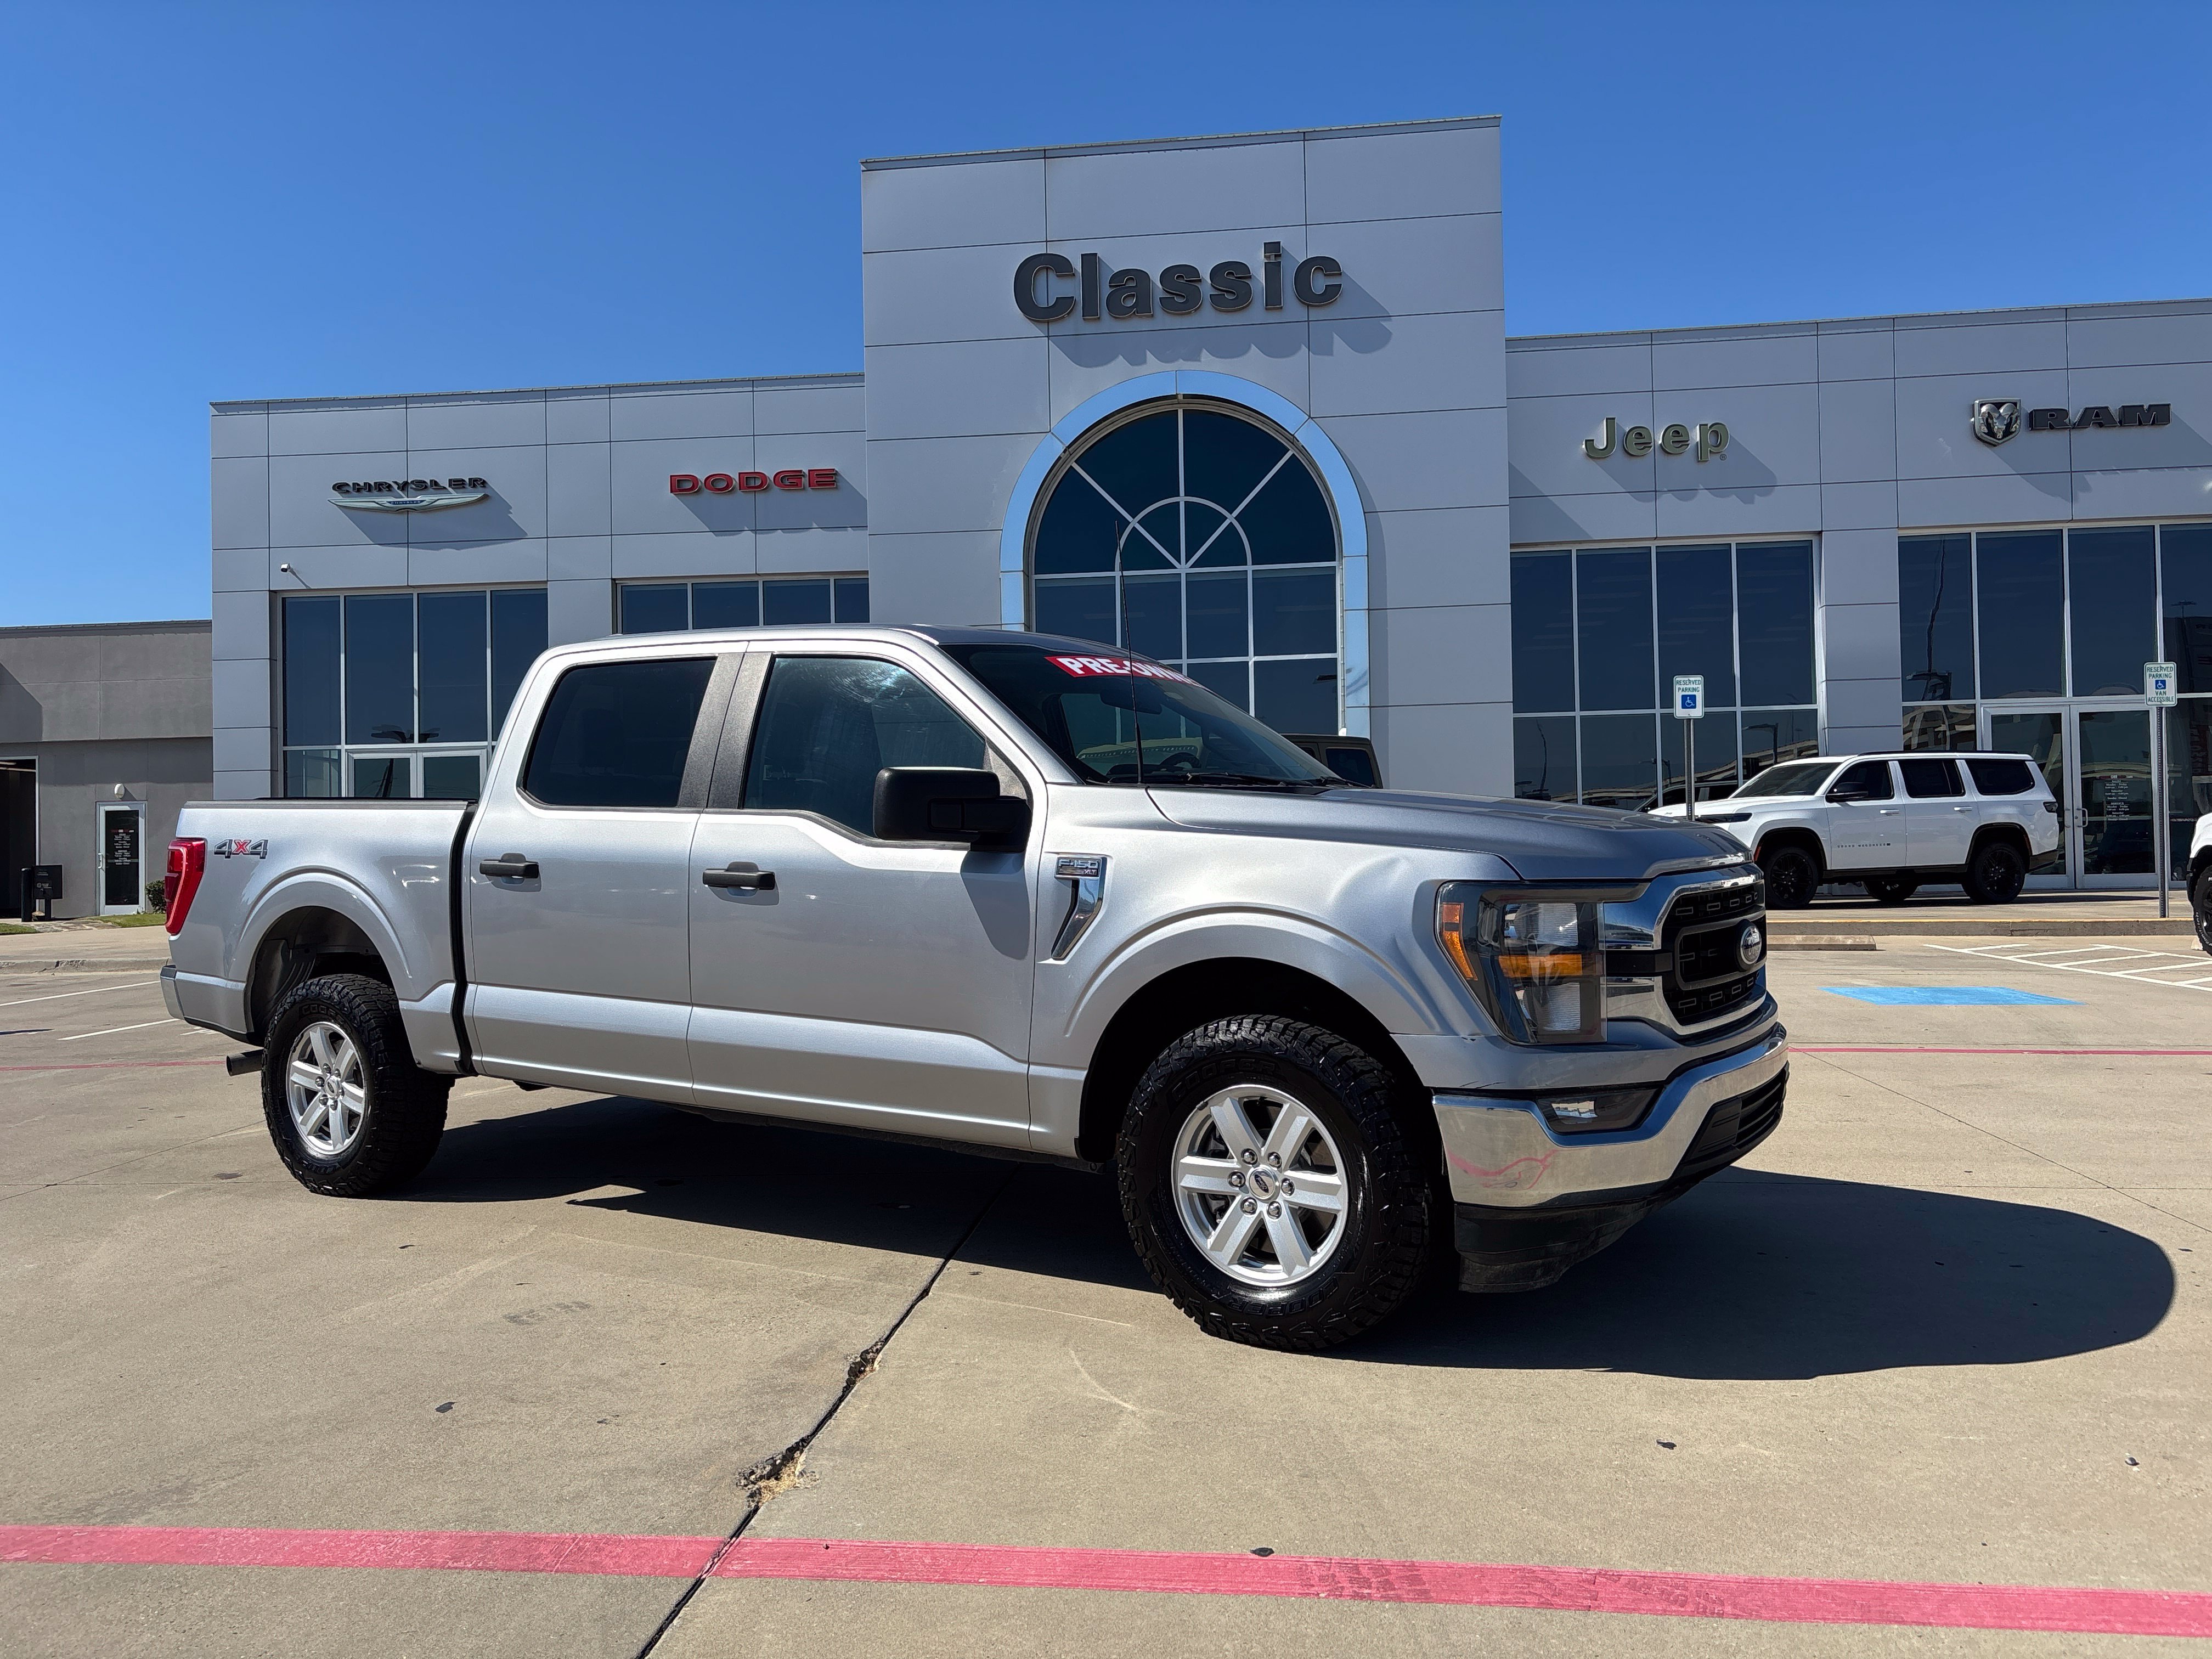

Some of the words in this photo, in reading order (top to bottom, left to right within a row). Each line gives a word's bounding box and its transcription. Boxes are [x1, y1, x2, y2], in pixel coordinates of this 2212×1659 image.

[1014, 241, 1342, 322] Classic
[2029, 403, 2171, 431] RAM
[1583, 417, 1730, 462] Jeep
[331, 477, 487, 493] CHRYSLER
[669, 468, 837, 494] DODGE
[1058, 859, 1099, 869] F-150
